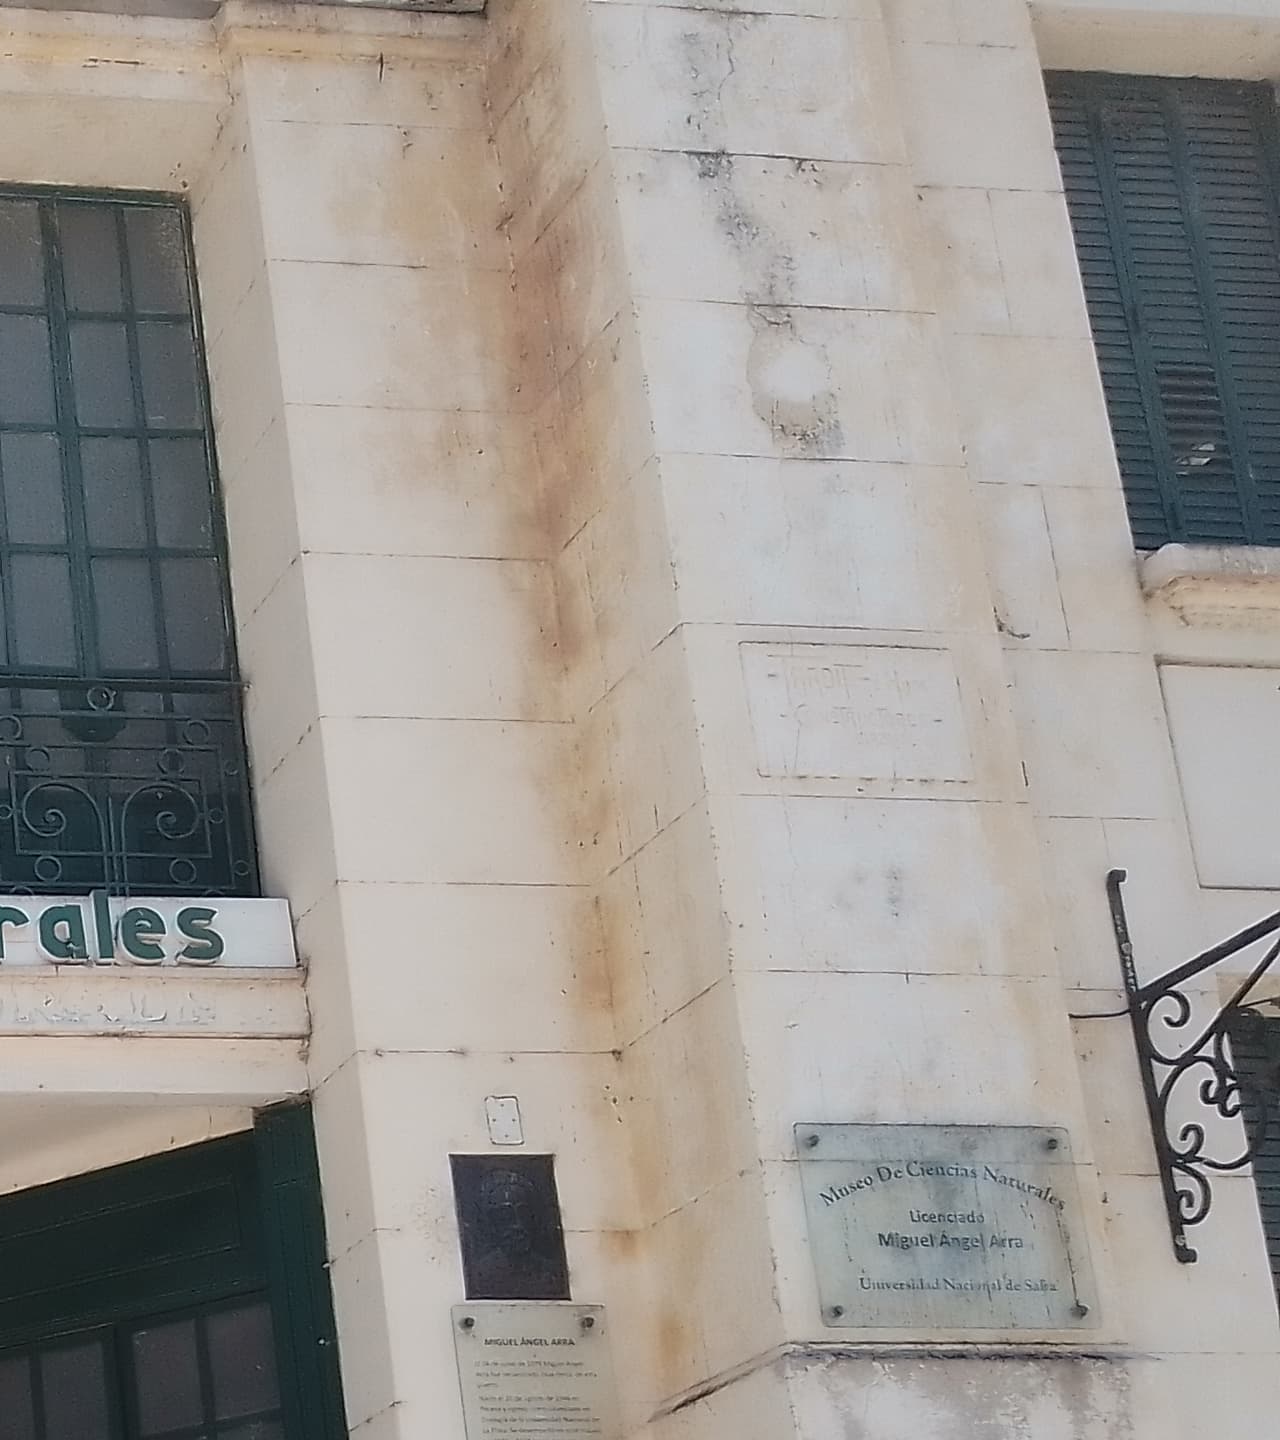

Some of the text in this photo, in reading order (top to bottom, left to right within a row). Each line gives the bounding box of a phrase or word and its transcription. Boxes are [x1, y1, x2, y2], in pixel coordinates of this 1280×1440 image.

[819, 1160, 1067, 1211] Museo De Ciencias Naturales
[910, 1210, 985, 1224] Licenciado
[878, 1233, 934, 1250] Miguel
[990, 1234, 1024, 1249] Arra
[860, 1277, 1058, 1293] Universidad Nacional de Salta
[484, 1338, 518, 1346] MIGUEL
[551, 1338, 576, 1346] ARRA
